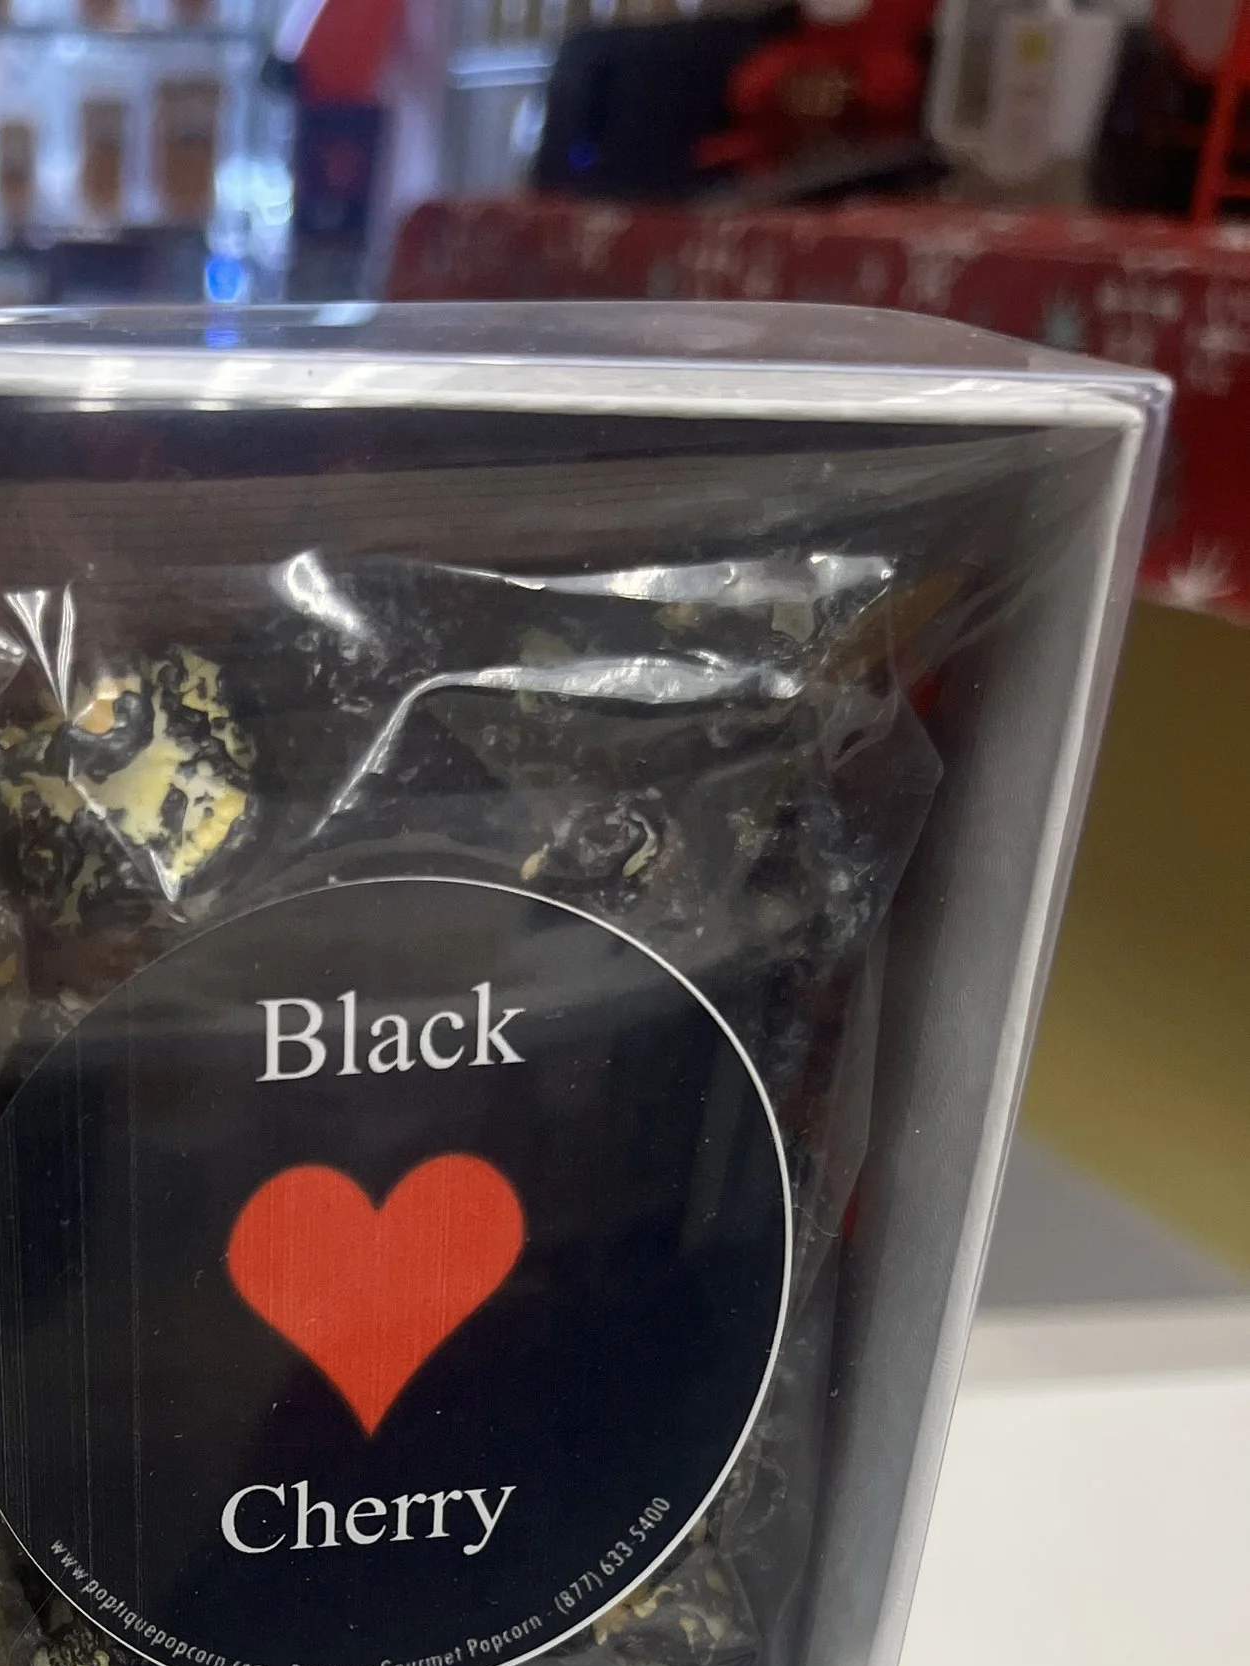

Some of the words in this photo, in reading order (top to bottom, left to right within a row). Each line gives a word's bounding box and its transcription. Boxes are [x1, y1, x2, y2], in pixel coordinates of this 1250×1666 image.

[255, 981, 528, 1083] Black
[220, 1482, 517, 1555] Cherry
[466, 1614, 544, 1657] Popcorn
[554, 1571, 603, 1615] (877)
[600, 1497, 671, 1576] 633-5400
